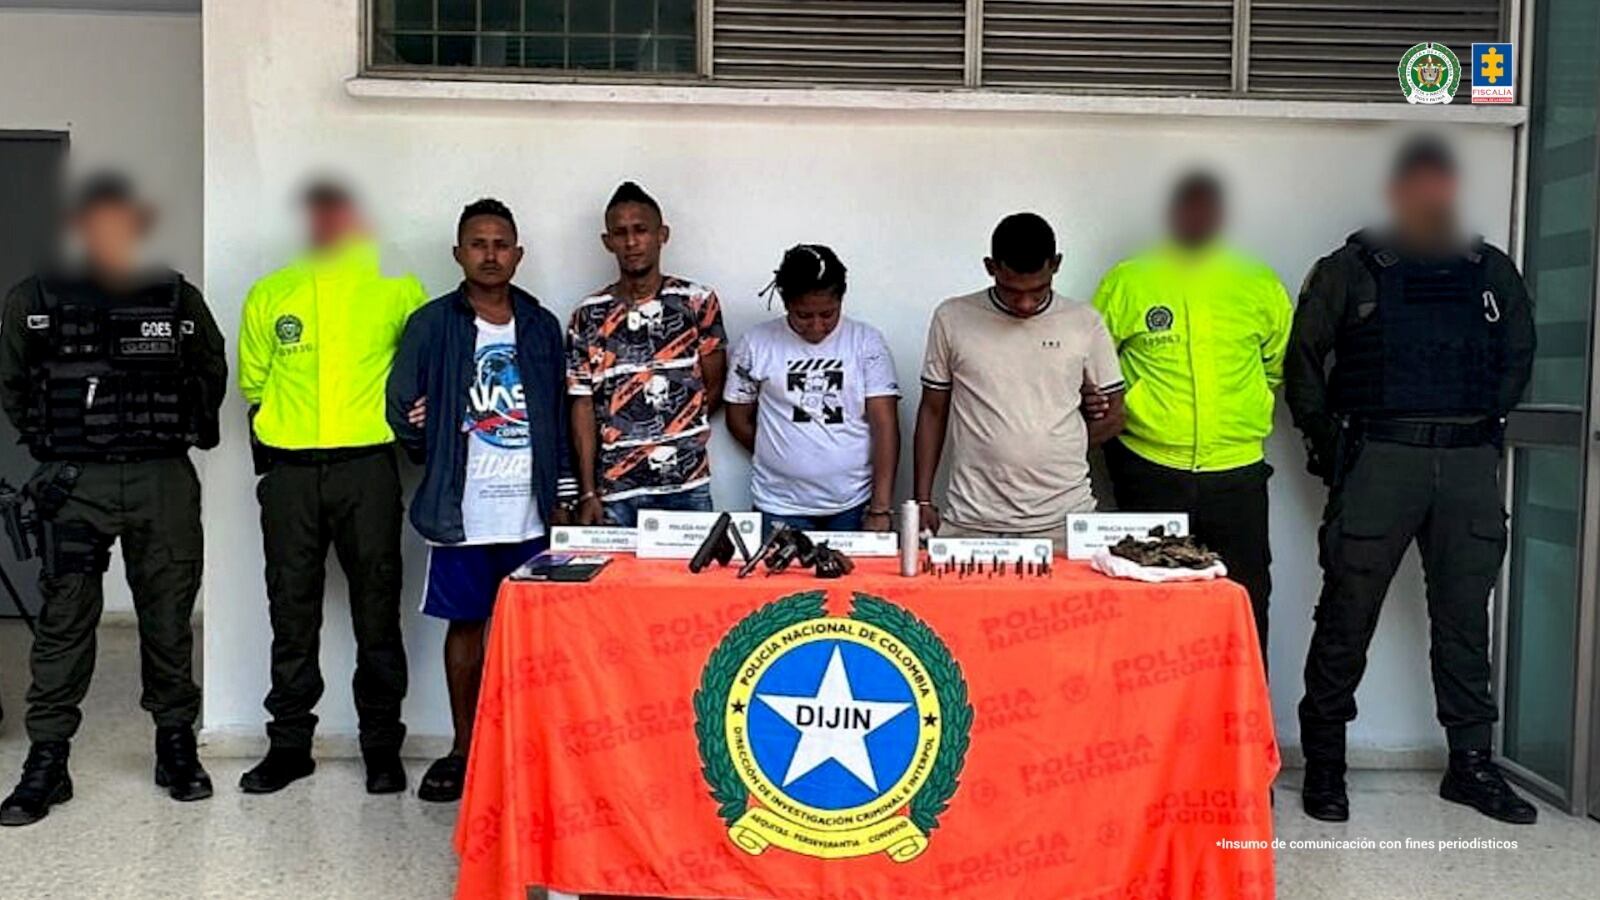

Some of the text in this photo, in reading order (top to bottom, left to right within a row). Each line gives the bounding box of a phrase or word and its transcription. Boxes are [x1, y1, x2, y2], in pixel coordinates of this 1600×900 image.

[141, 321, 172, 337] GOES
[979, 588, 1121, 637] POLICIA
[986, 607, 1123, 653] NACIONAL
[782, 623, 855, 645] NACIONAL
[859, 627, 879, 642] DE
[879, 638, 930, 697] COLOMBIA
[1111, 632, 1242, 680] POLICIA
[1116, 654, 1248, 695] NACIONAL
[796, 705, 872, 729] DIJIN
[758, 784, 772, 797] DE
[856, 795, 904, 822] CRIMINAL
[902, 786, 911, 794] E
[908, 737, 935, 787] INTERPOL
[1018, 733, 1154, 784] POLICIA
[1023, 750, 1159, 798] NACIONAL
